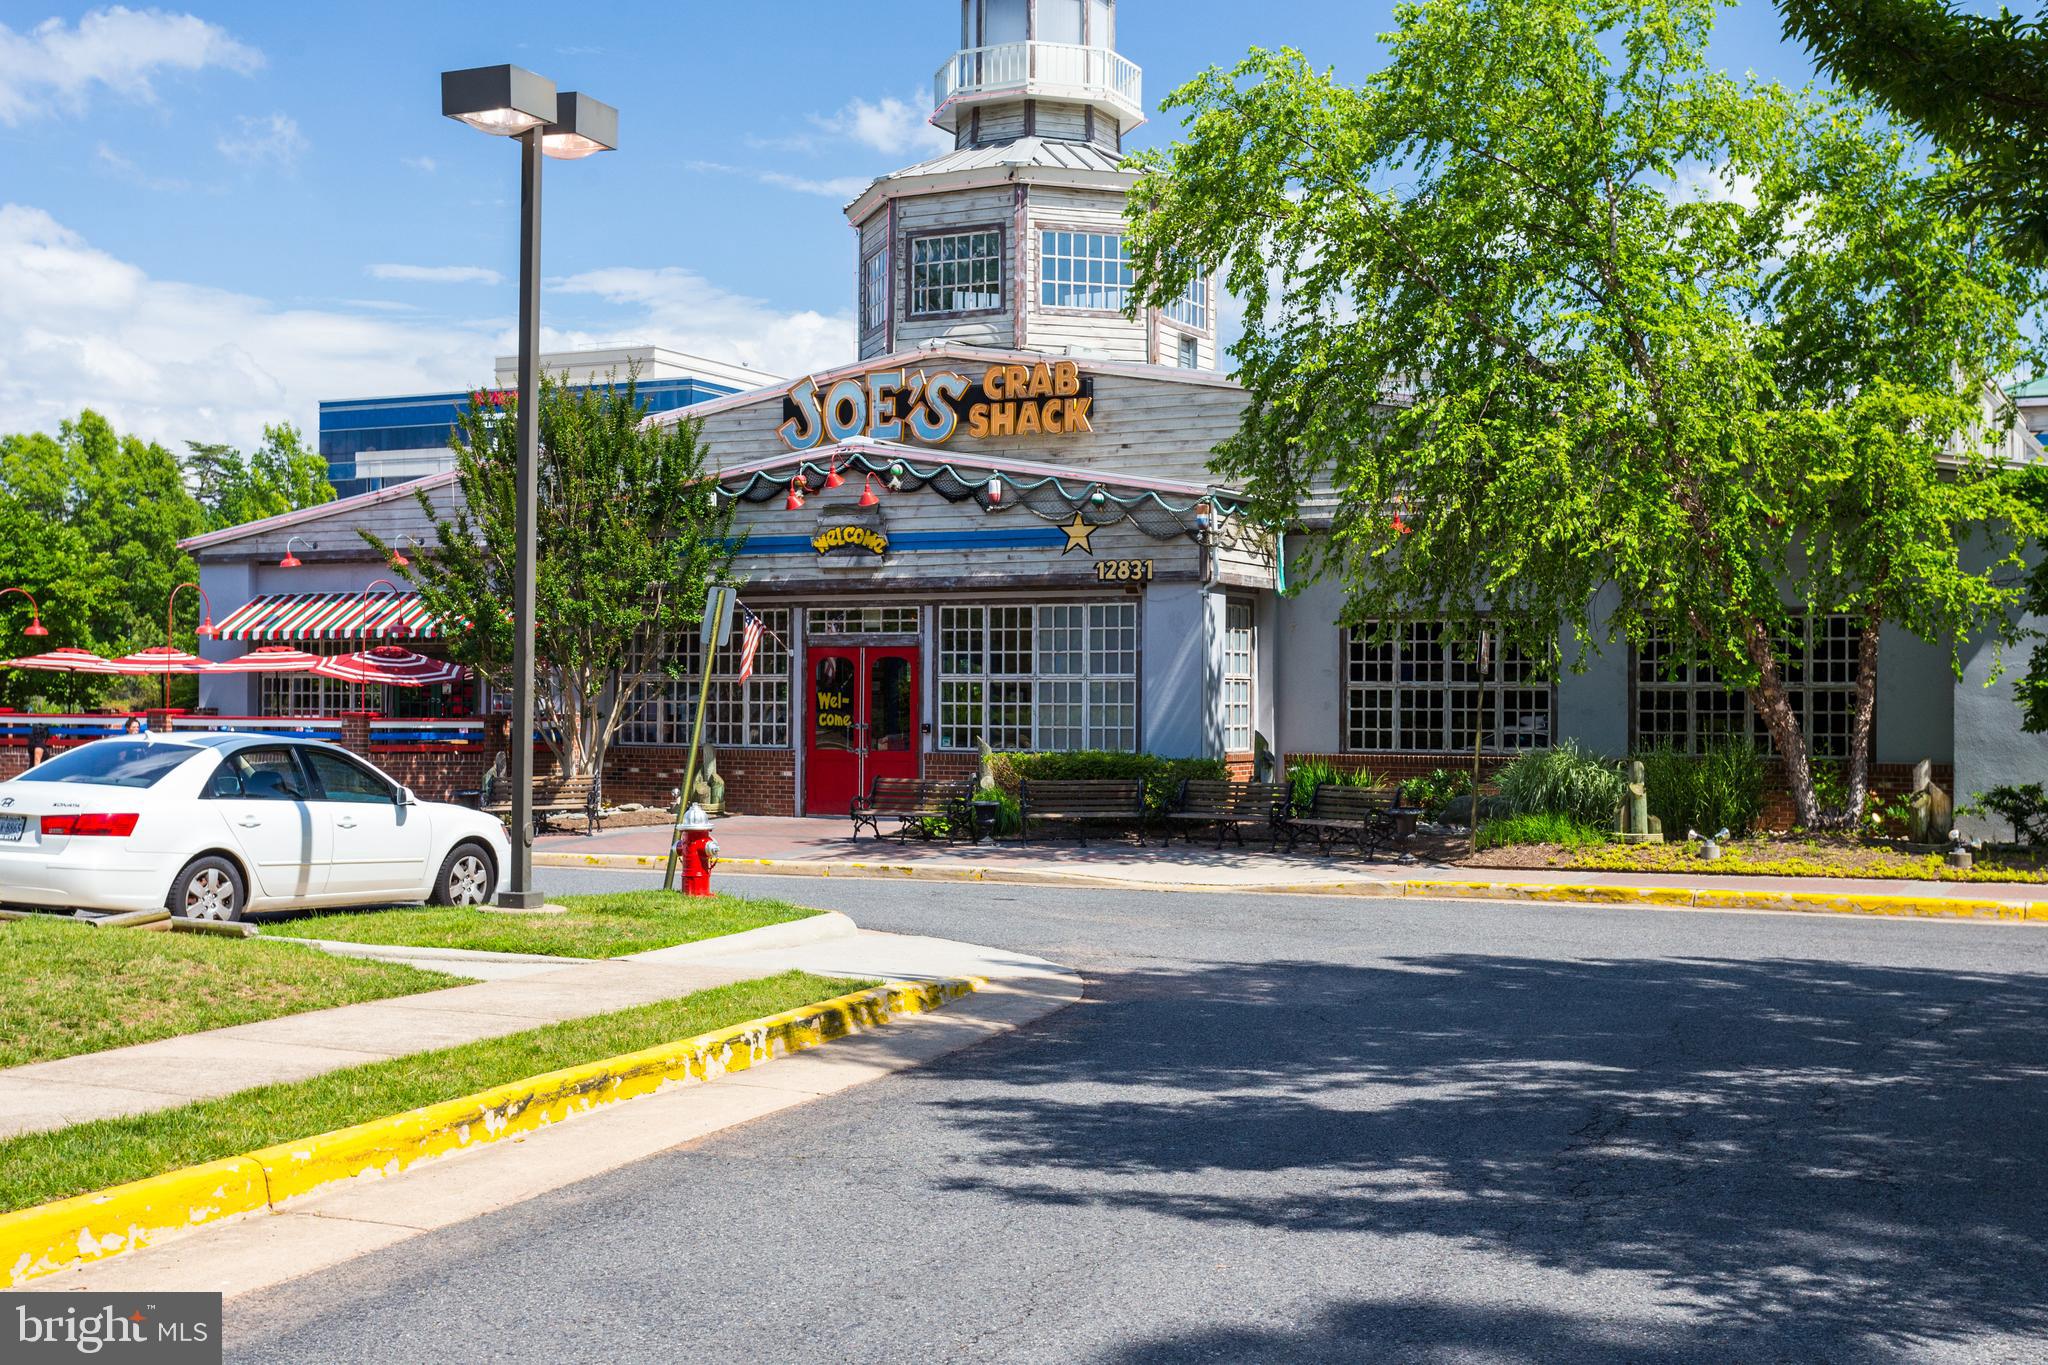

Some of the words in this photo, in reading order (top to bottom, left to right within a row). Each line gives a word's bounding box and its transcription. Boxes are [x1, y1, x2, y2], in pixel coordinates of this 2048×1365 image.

[982, 360, 1081, 400] CRAB
[775, 367, 972, 450] JOE'S
[967, 396, 1094, 439] SHACK
[1094, 559, 1153, 581] 12831
[817, 691, 850, 710] Wel-
[818, 712, 853, 728] come
